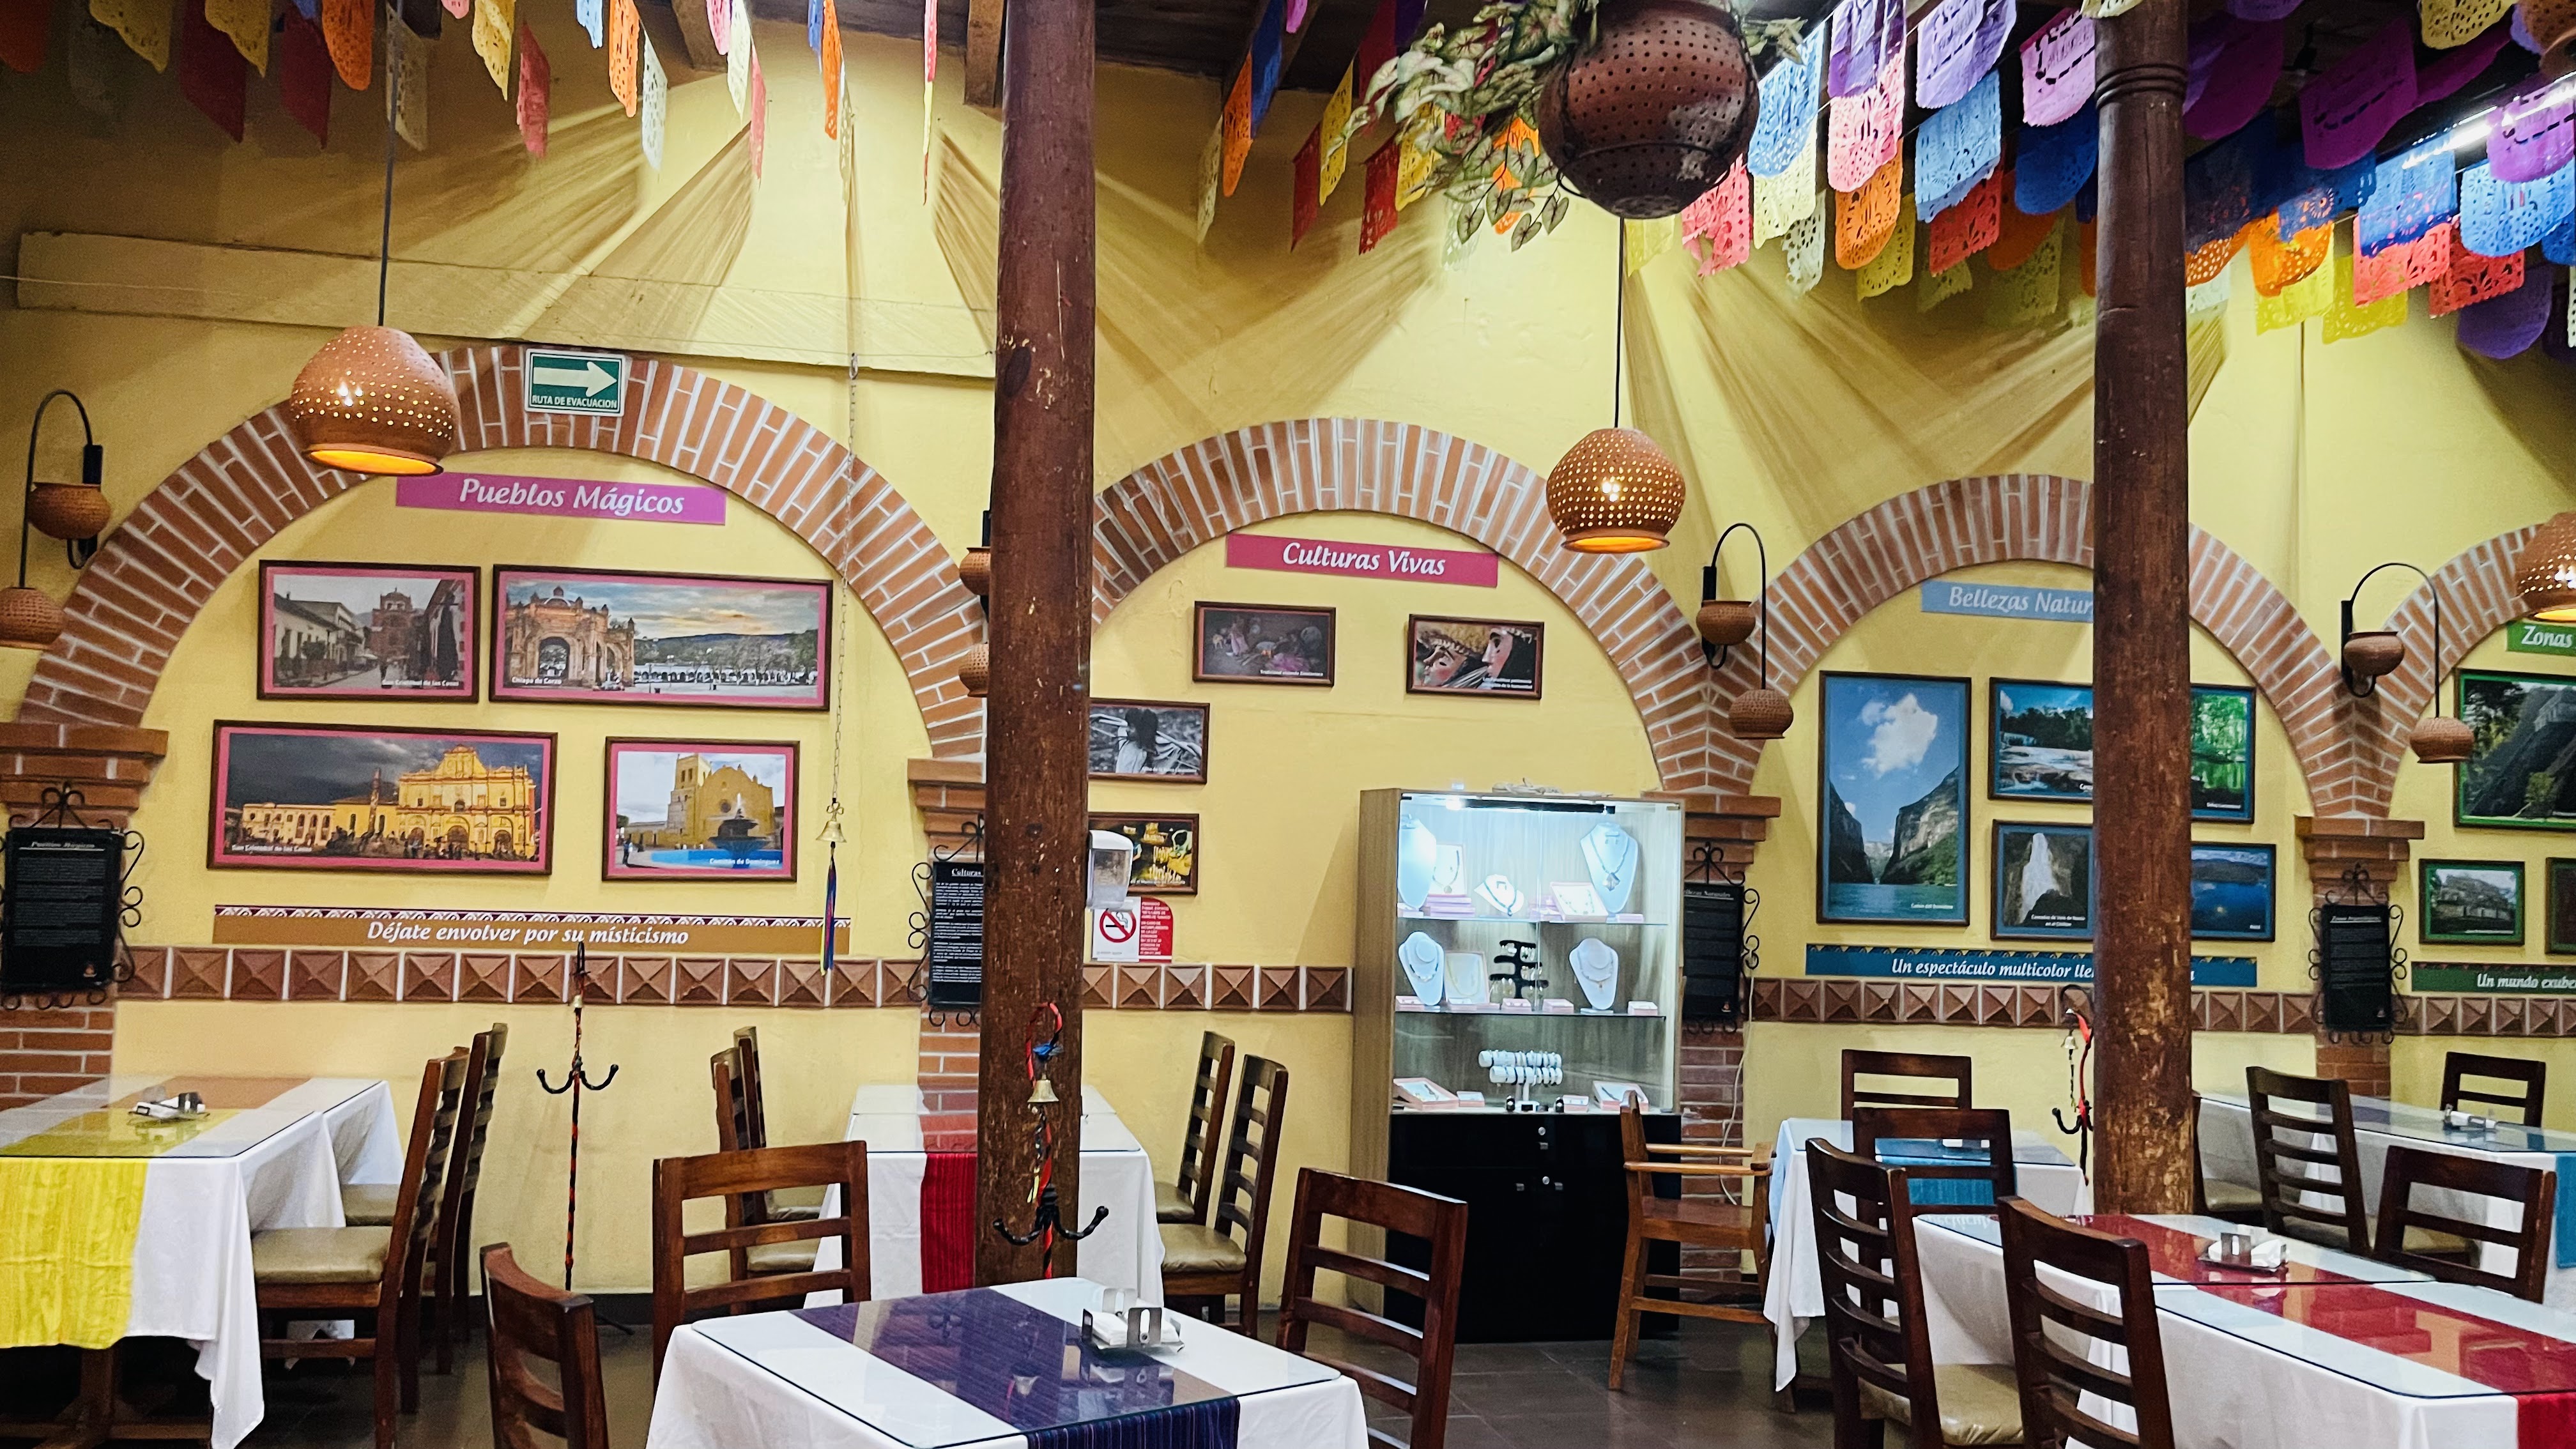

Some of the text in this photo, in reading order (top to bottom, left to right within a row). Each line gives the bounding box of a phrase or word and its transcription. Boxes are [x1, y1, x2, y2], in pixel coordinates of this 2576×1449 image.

[532, 395, 617, 408] RUTA DE EVACUACION
[459, 478, 685, 516] Pueblos Mágicos
[1282, 542, 1446, 575] Culturas Vivas
[1949, 586, 2029, 613] Bellezas
[2521, 625, 2573, 648] Zonas
[367, 921, 432, 943] Déjate
[436, 924, 521, 942] envolver
[523, 928, 558, 945] por
[562, 928, 585, 942] su
[1892, 958, 1912, 974] Un
[1915, 960, 1996, 977] espectáculo
[1999, 962, 2072, 977] multicolor
[2477, 973, 2494, 987] Un
[2497, 975, 2539, 988] mundo
